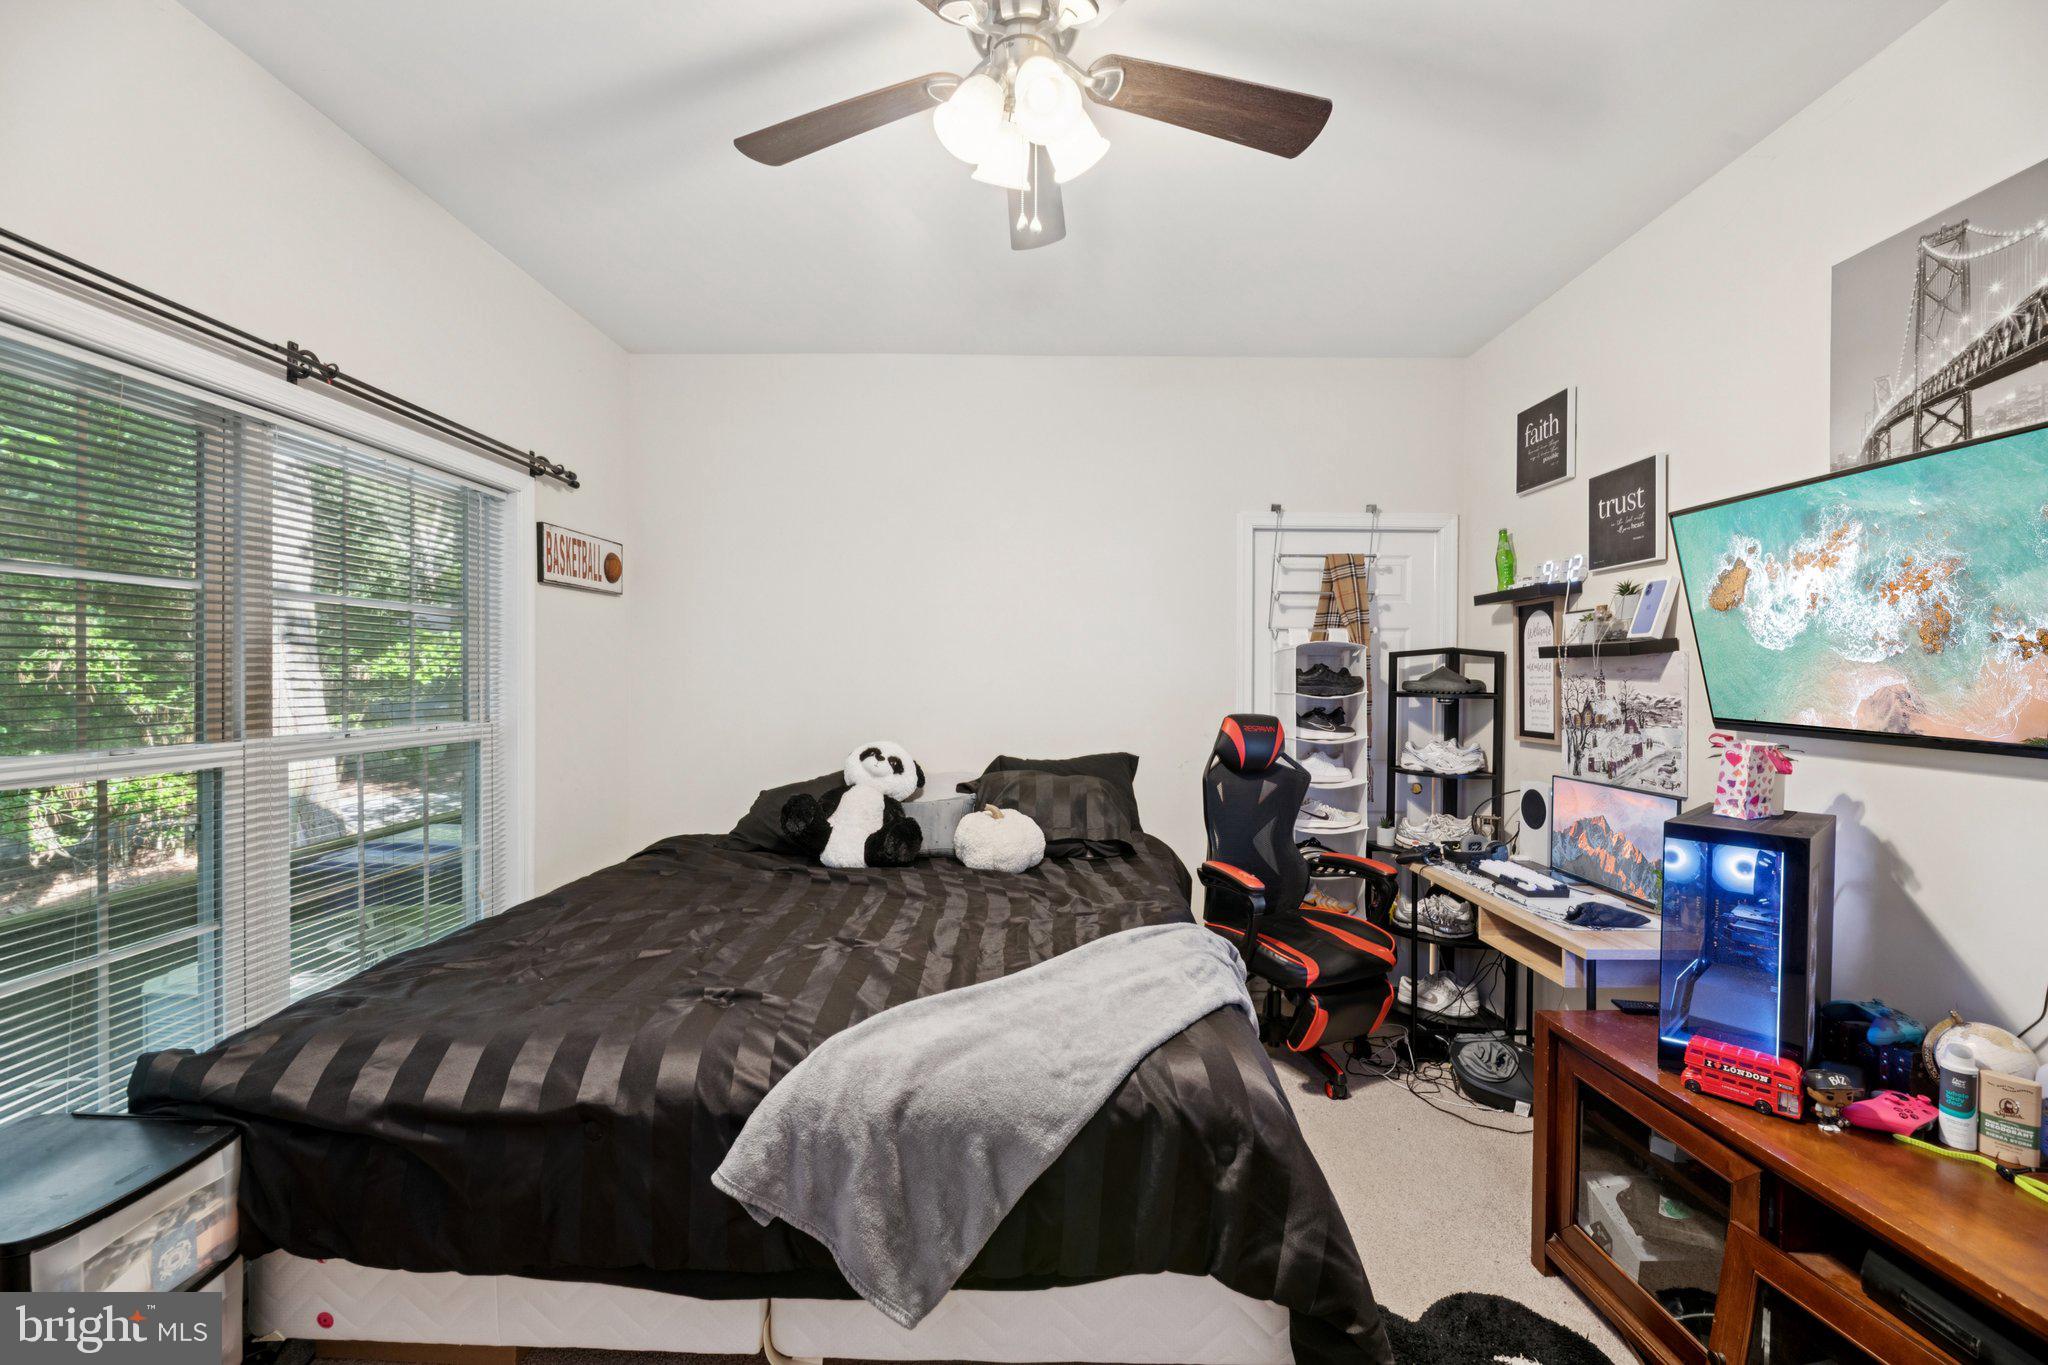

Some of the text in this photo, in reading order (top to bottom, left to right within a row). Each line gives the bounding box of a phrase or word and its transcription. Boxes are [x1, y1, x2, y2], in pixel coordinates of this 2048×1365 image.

[1525, 413, 1559, 448] faith
[1598, 487, 1646, 519] trust
[546, 530, 602, 582] BASKETBALL
[1722, 1065, 1769, 1083] LONDON
[1828, 1075, 1847, 1086] BIZ
[1985, 1121, 2034, 1139] DEODORANT
[2009, 1137, 2033, 1147] STORM
